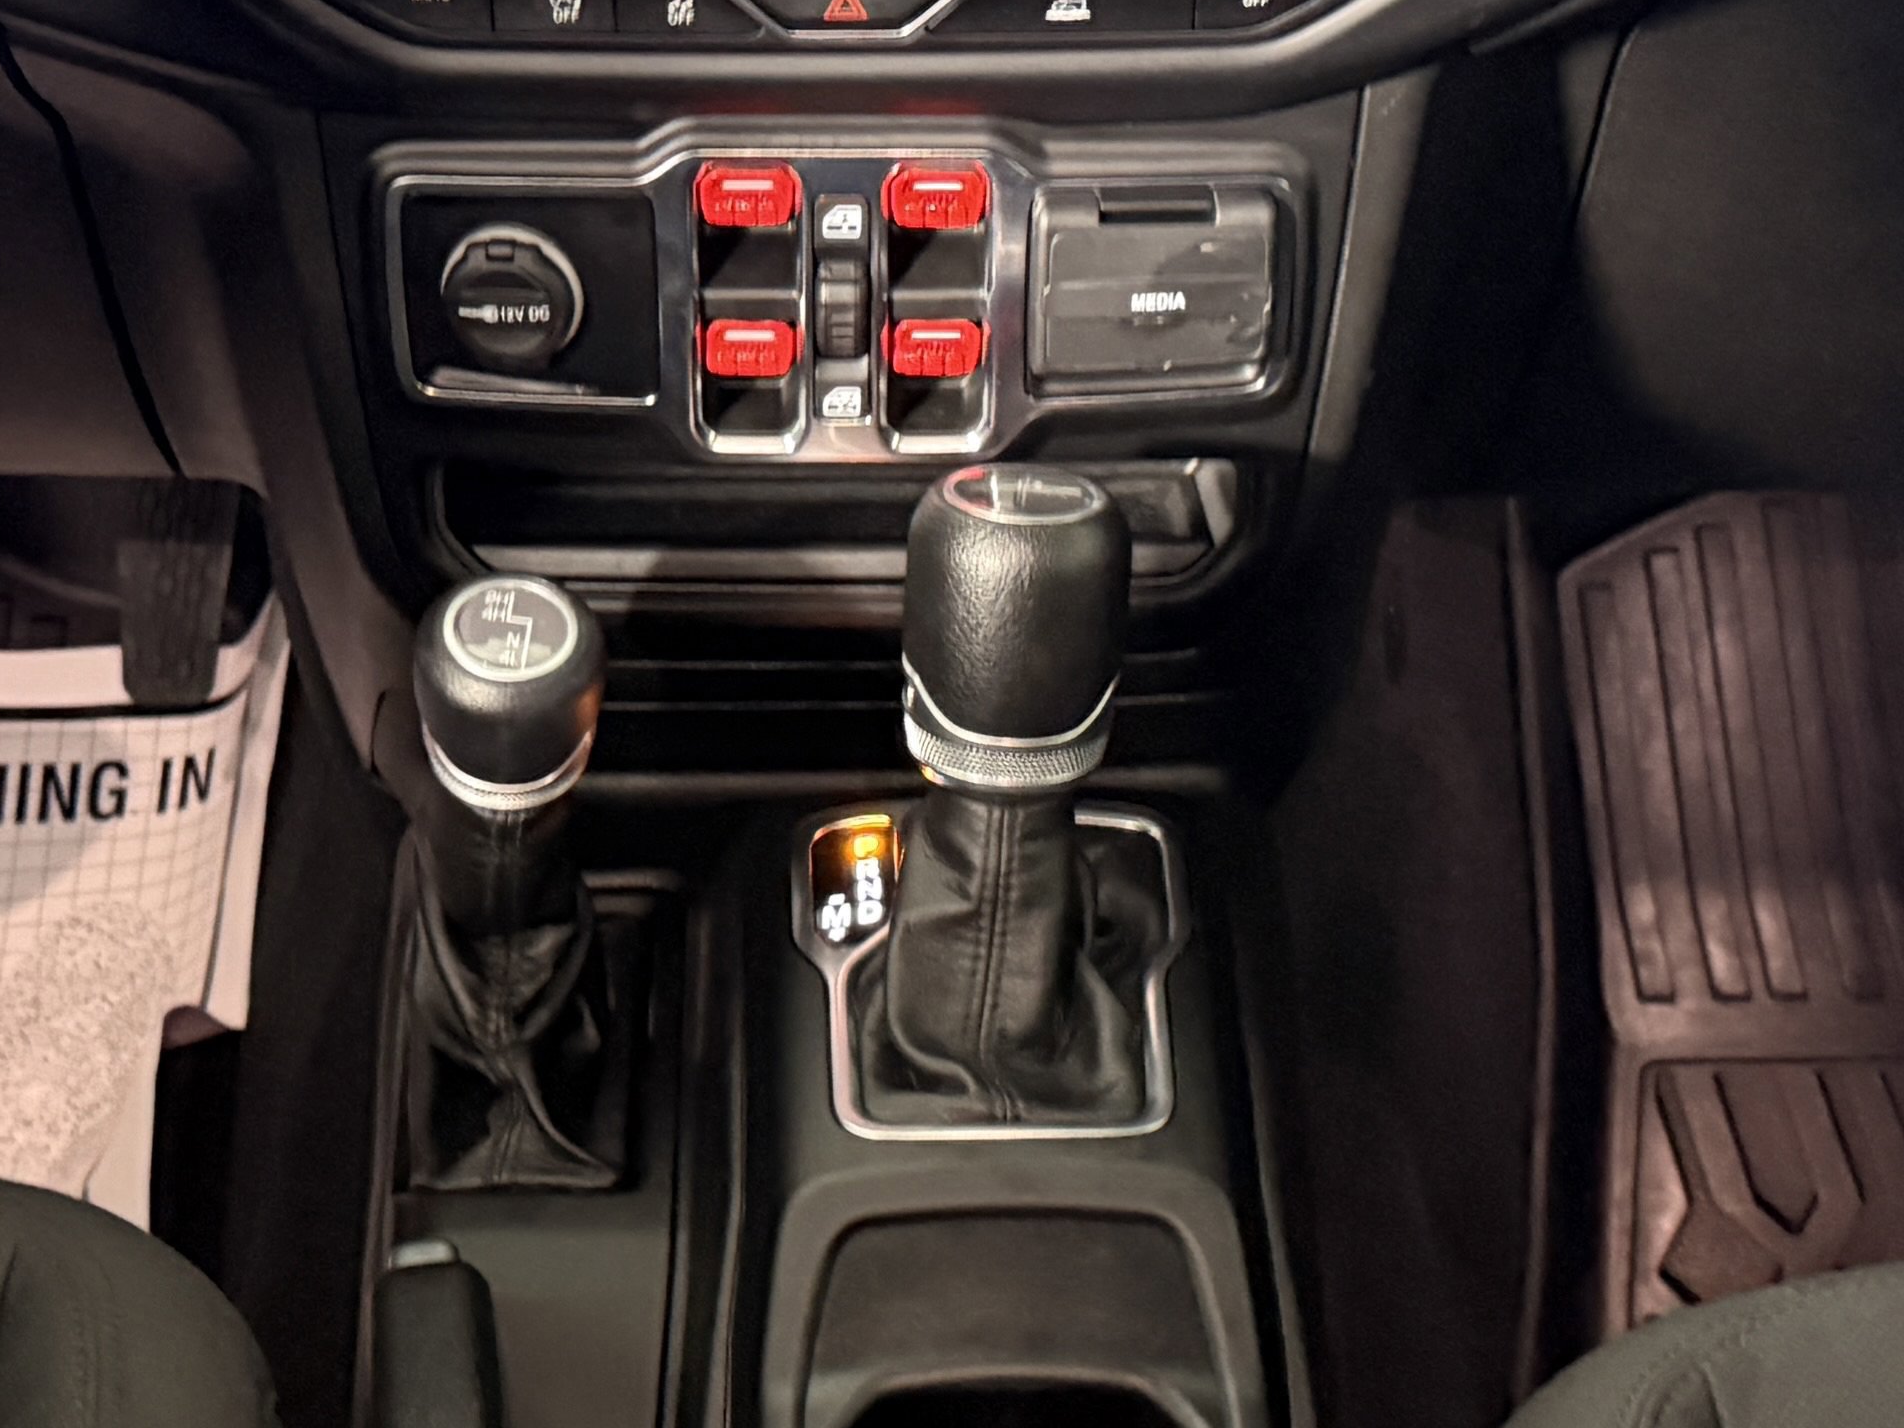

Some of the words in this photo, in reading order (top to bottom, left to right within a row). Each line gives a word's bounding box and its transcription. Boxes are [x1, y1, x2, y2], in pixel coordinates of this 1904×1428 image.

[1130, 290, 1187, 314] MEDIA
[156, 746, 216, 816] IN
[857, 876, 883, 902] N
[821, 902, 852, 930] M
[857, 900, 884, 926] D
